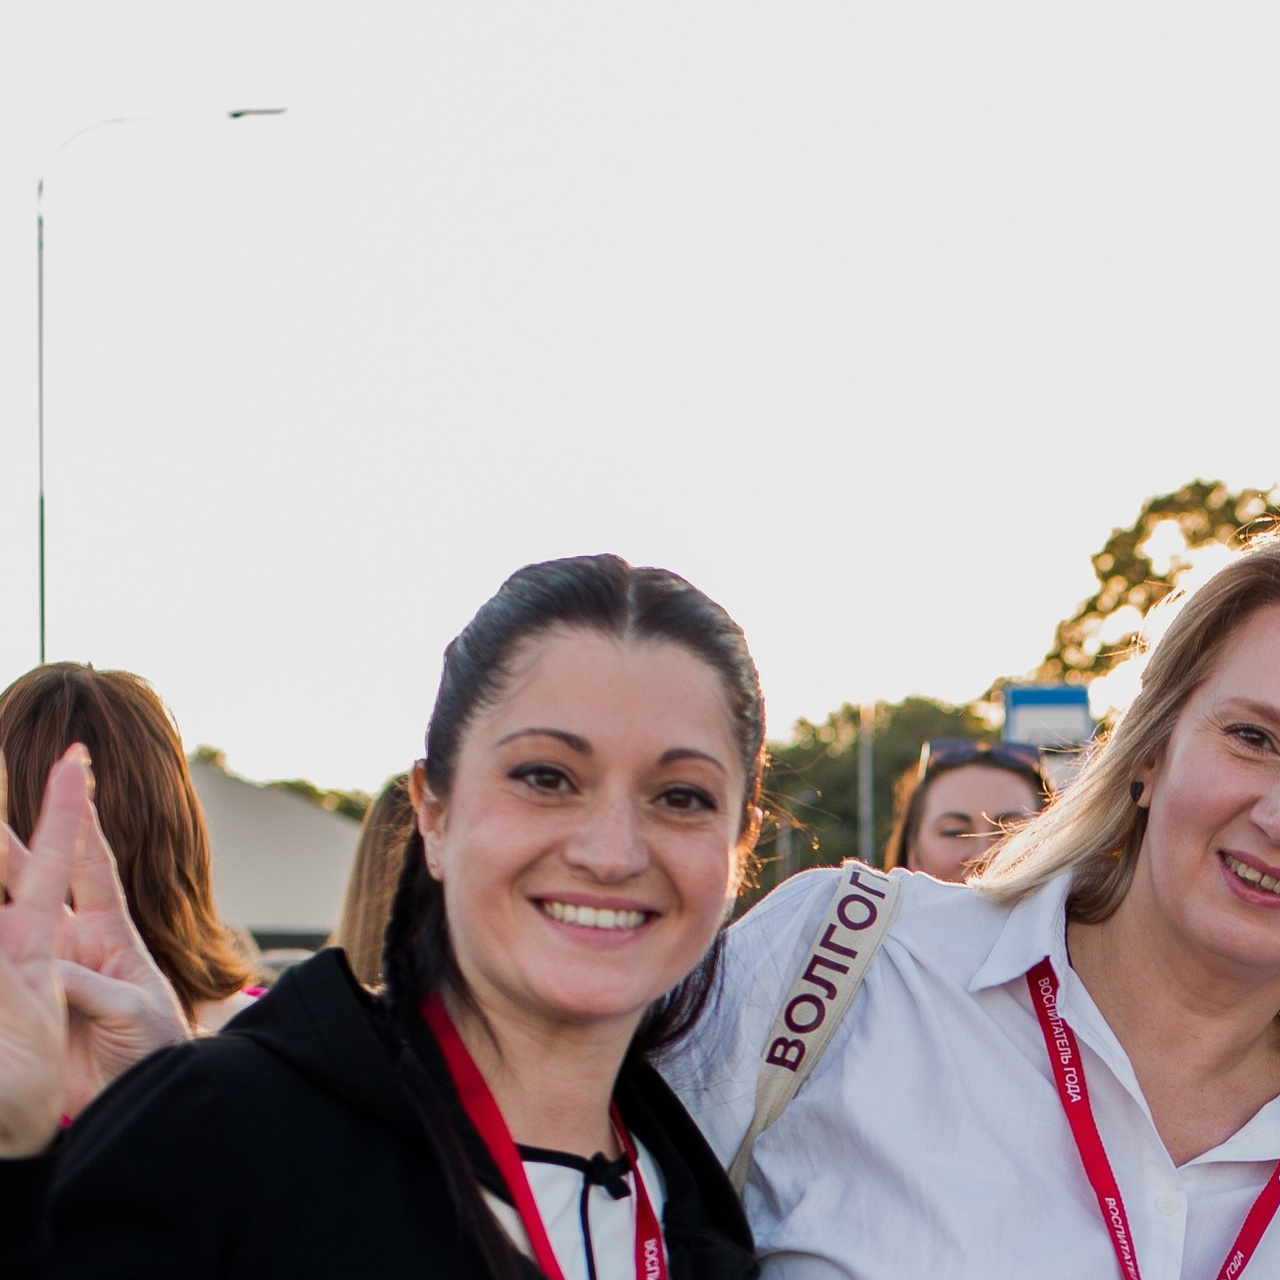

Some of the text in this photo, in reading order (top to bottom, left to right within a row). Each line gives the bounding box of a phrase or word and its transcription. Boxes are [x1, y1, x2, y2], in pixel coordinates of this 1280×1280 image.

[766, 871, 888, 1073] ВОЛГОГ
[1038, 977, 1081, 1103] ВОСПИТАТЕЛЬ ГОДА
[1225, 1250, 1245, 1280] ГОДА
